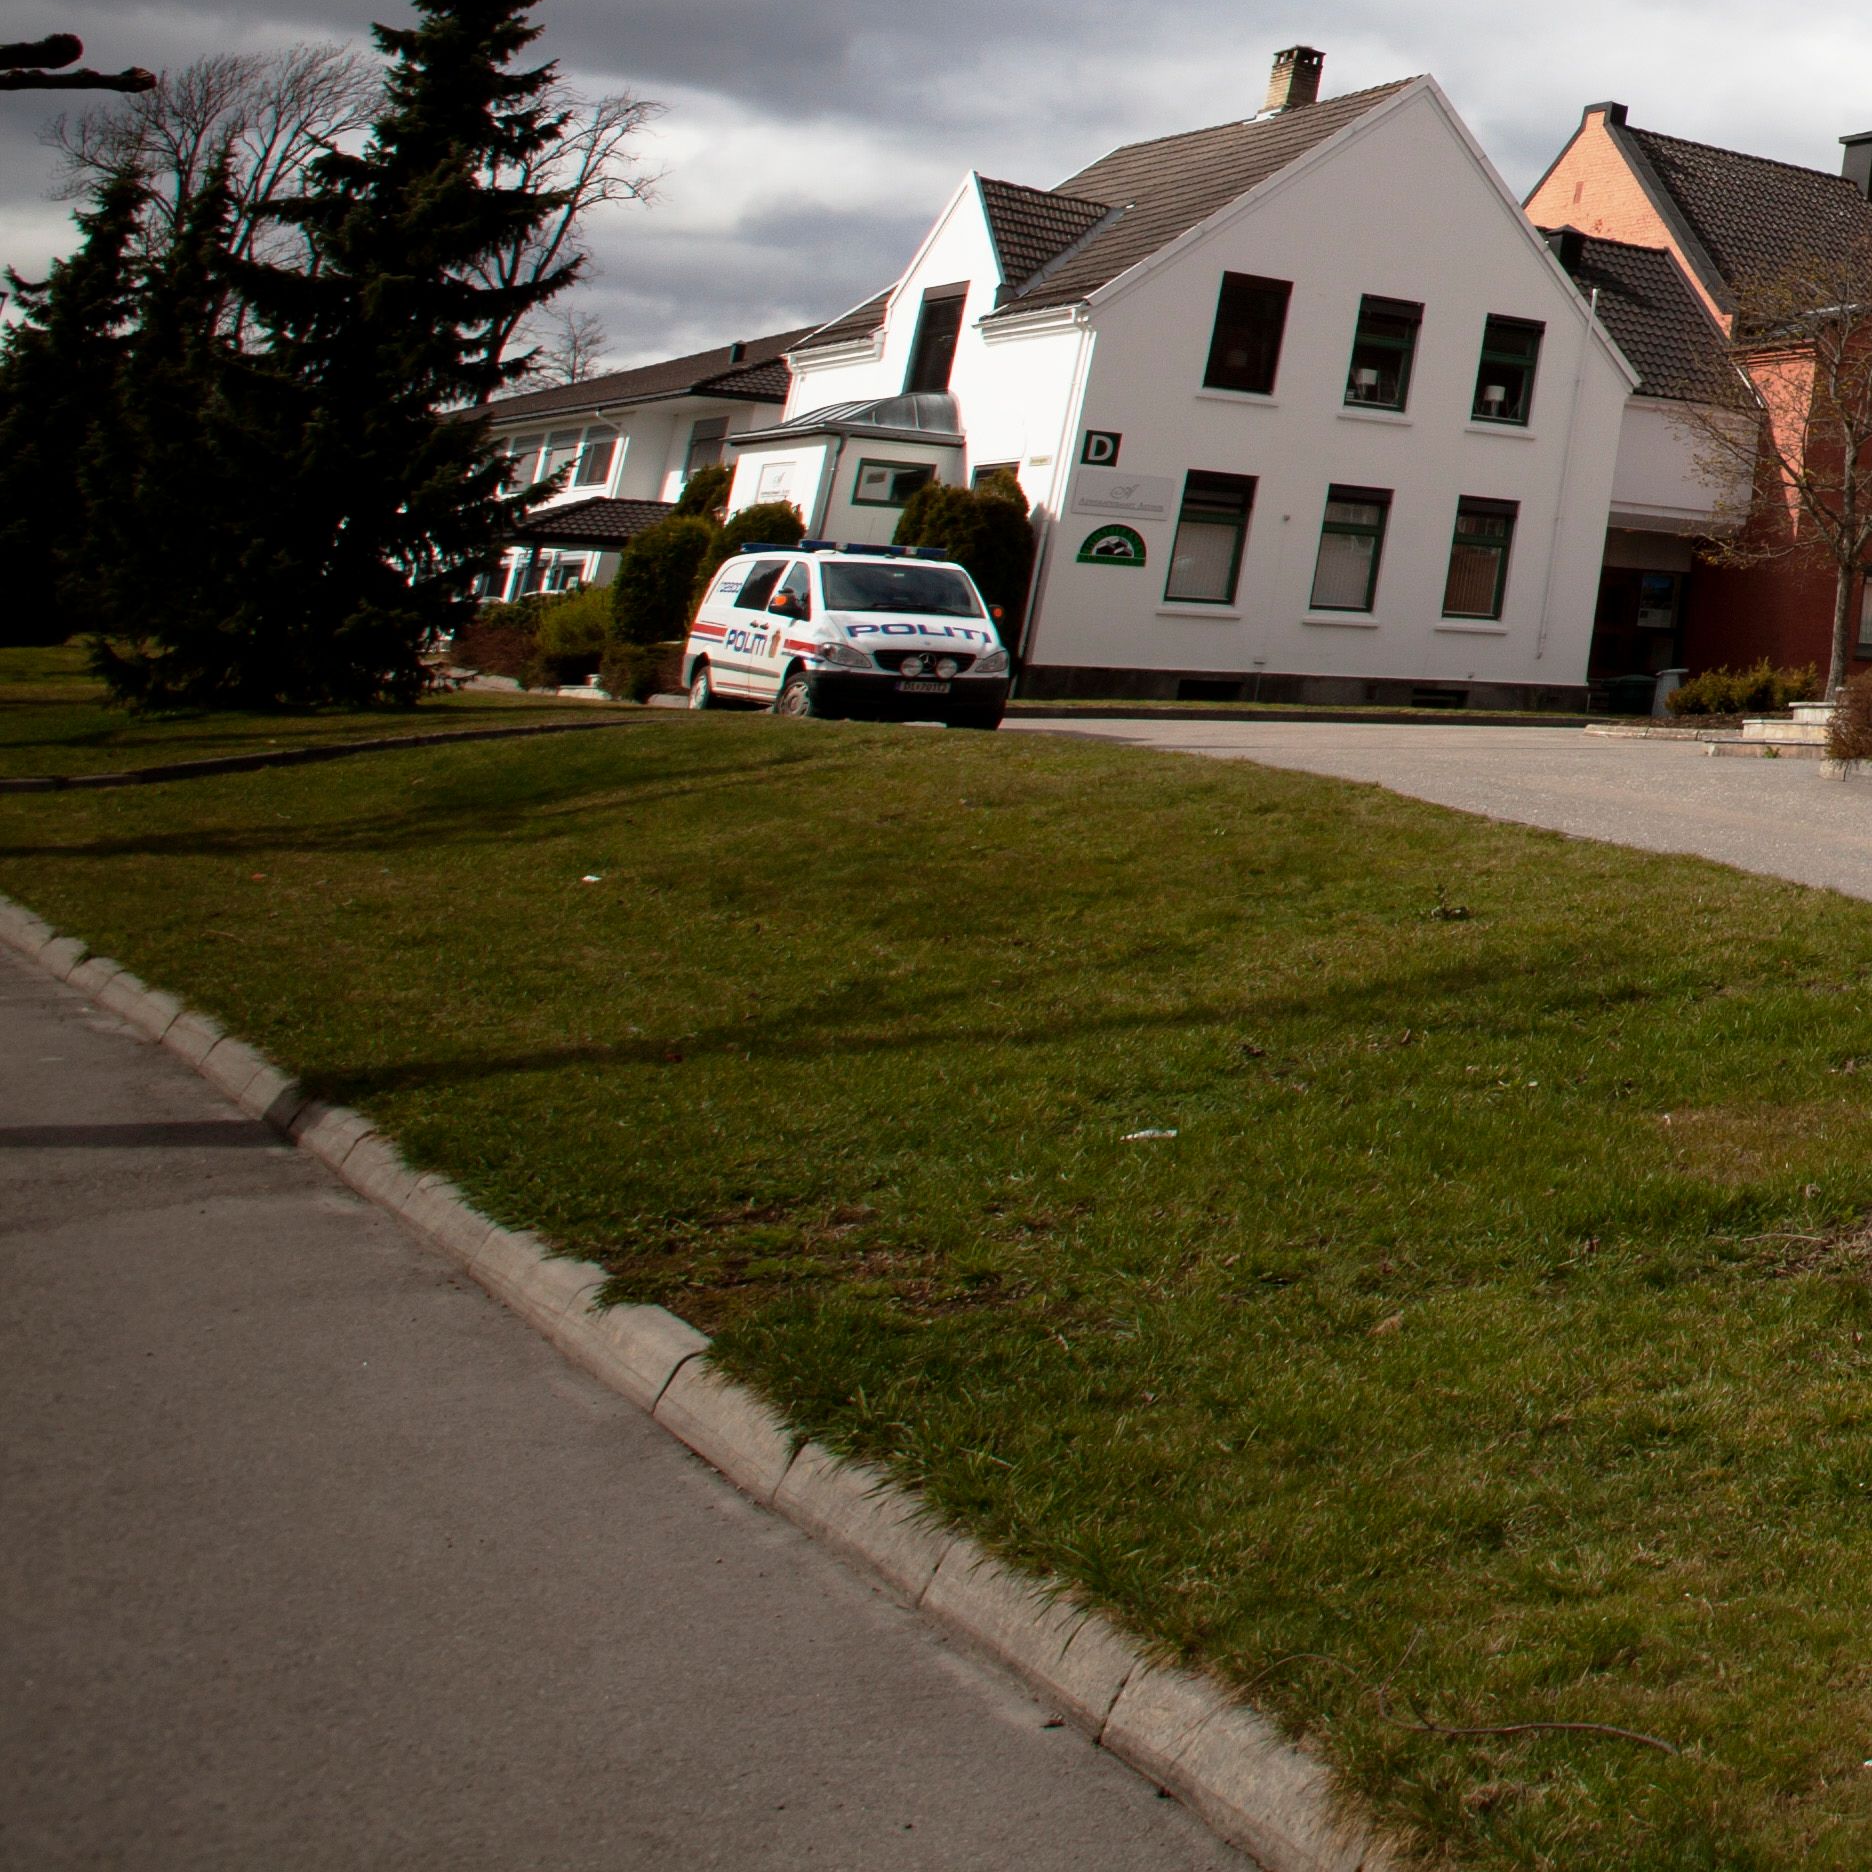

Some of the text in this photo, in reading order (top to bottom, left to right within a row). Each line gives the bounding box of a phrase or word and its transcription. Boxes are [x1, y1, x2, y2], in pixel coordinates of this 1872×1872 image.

[1087, 434, 1114, 461] D
[725, 629, 769, 657] POLITI
[845, 623, 993, 644] POLITI
